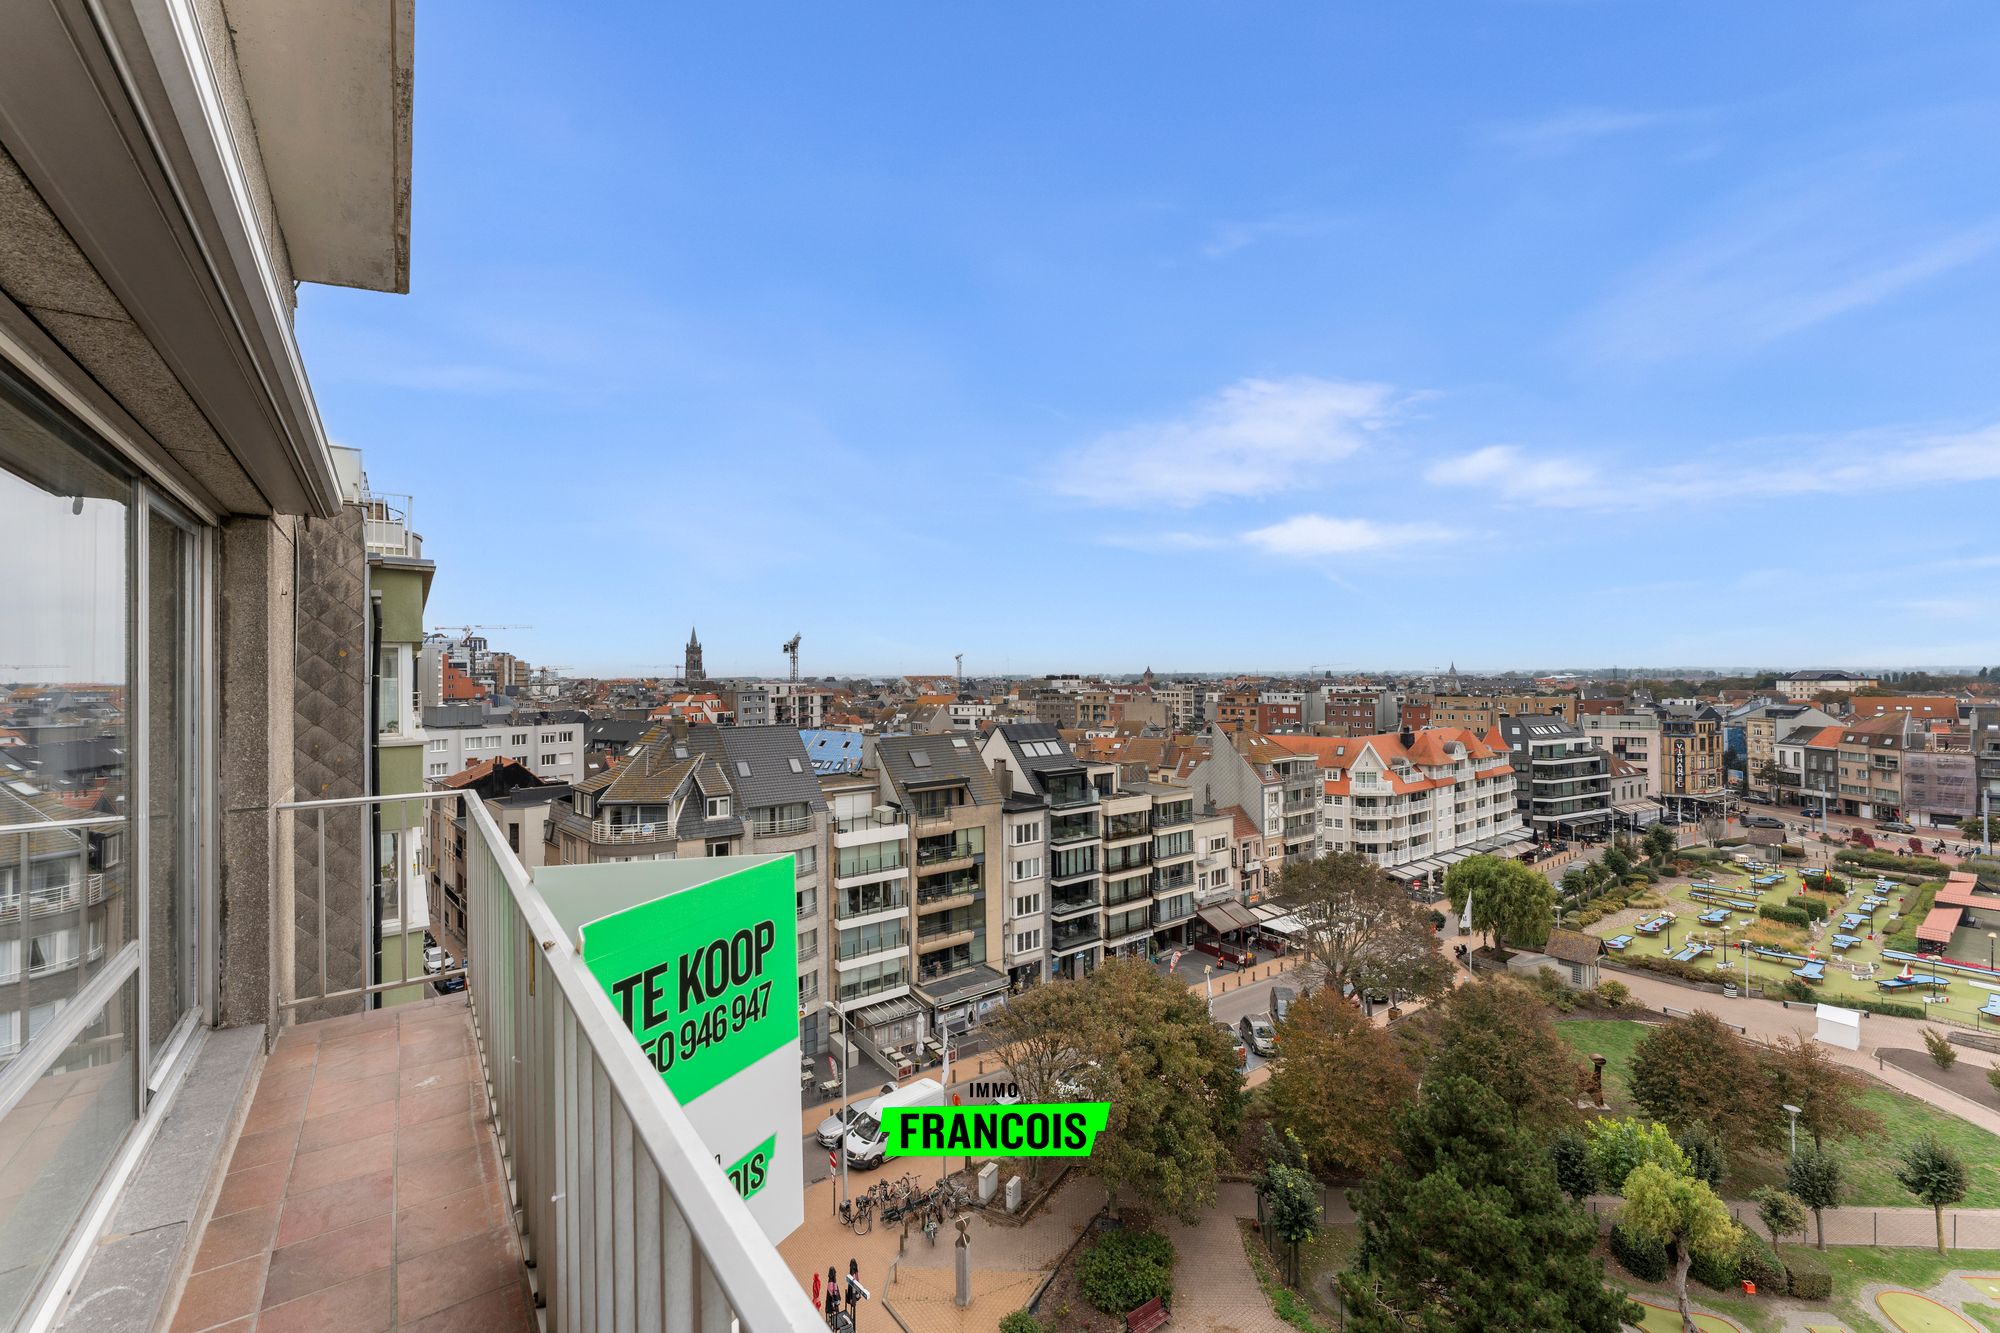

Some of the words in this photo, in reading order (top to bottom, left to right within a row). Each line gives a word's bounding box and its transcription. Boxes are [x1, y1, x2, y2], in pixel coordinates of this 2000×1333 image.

[612, 962, 668, 1034] TE
[678, 920, 775, 1015] KOOP
[680, 1004, 728, 1060] 946
[732, 980, 773, 1033] 947
